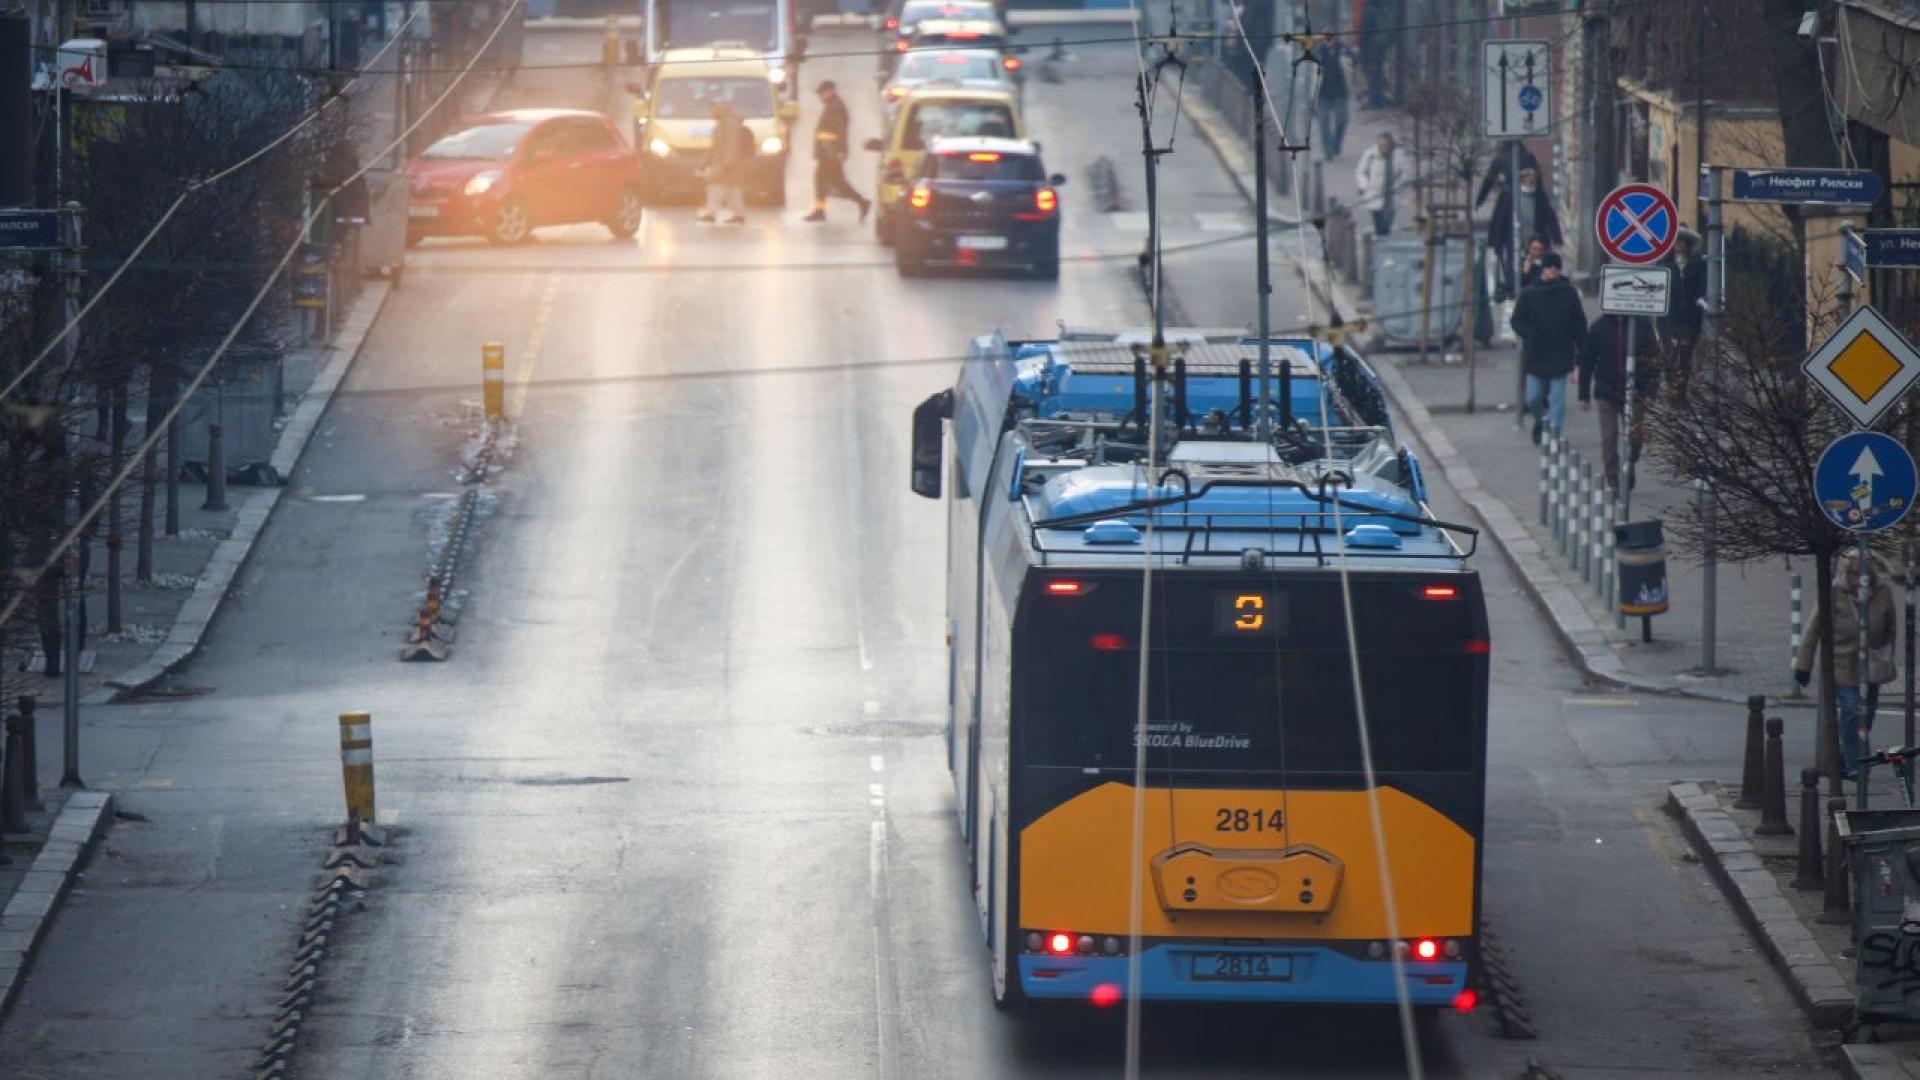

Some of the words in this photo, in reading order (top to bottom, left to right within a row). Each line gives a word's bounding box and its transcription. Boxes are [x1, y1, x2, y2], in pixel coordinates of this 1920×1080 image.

[1769, 176, 1816, 188] Неофит
[1820, 177, 1864, 189] Рилски
[1900, 238, 1920, 250] Не
[1133, 721, 1178, 733] pwered
[1184, 734, 1250, 748] BlueDrive
[1215, 807, 1285, 832] 2814
[1215, 955, 1270, 976] 2814
